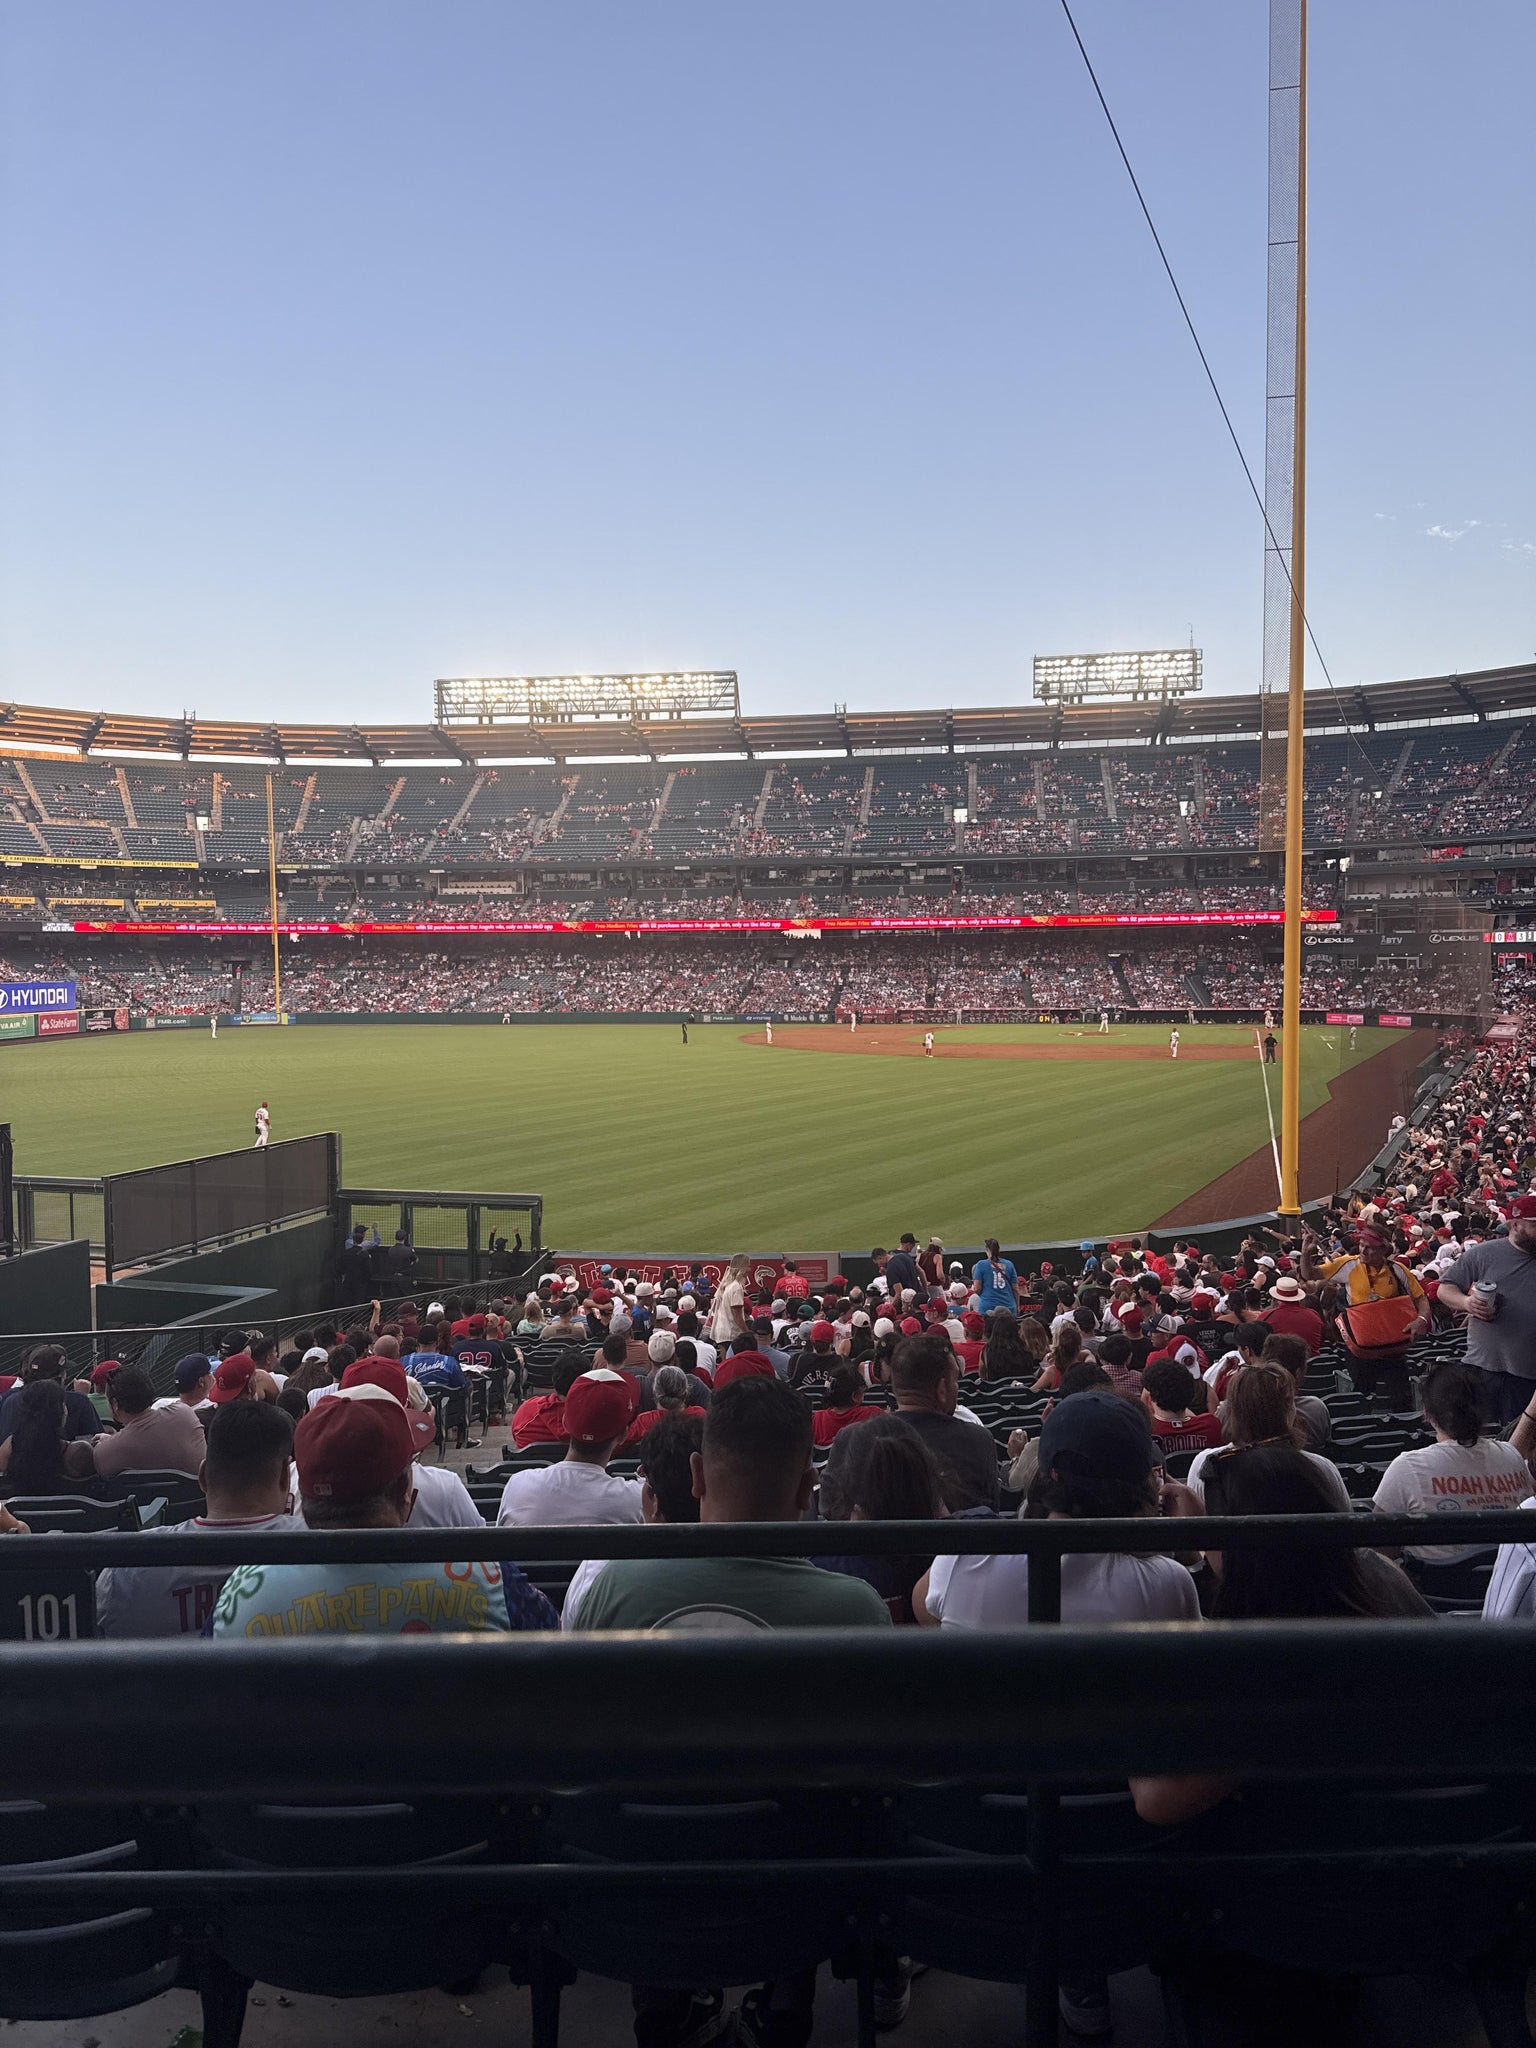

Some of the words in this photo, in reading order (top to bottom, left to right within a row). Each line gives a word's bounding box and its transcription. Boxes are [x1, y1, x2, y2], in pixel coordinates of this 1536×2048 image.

[12, 988, 67, 1006] HYUNDAI
[1432, 1476, 1484, 1495] NOAH
[18, 1594, 77, 1640] 101
[172, 1583, 222, 1632] TR
